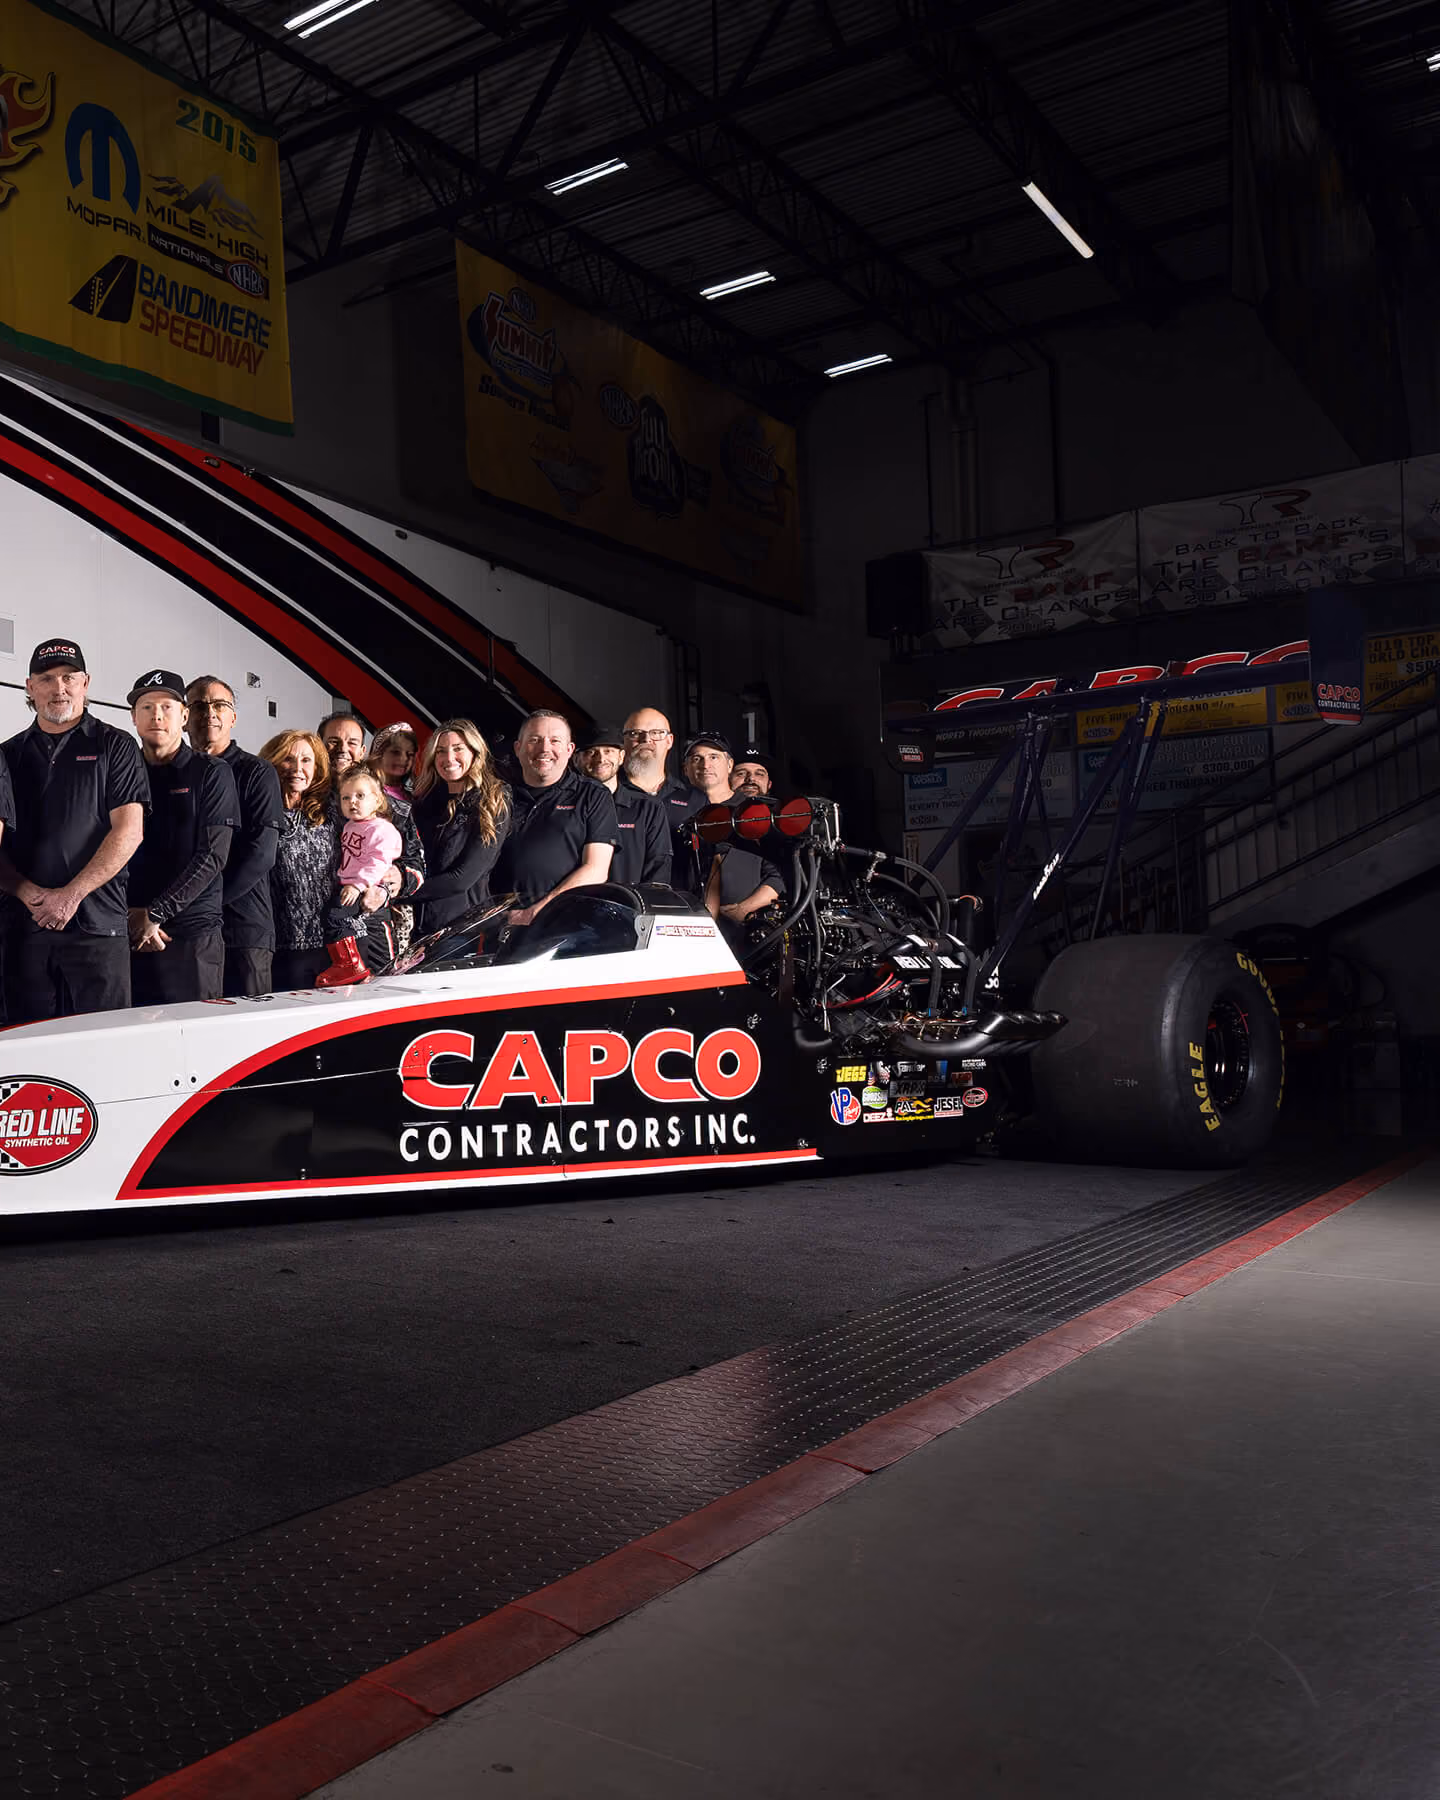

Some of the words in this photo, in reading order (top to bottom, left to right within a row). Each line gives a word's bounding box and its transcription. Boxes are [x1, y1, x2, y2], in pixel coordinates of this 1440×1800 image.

[175, 99, 257, 164] 2015
[151, 233, 224, 274] NATIONALS
[138, 263, 271, 349] BANDIMERE
[139, 299, 265, 376] SPEEDWAY
[1175, 537, 1237, 555] BACK
[1295, 516, 1363, 535] BACK
[1152, 577, 1216, 595] ARE
[1240, 549, 1393, 581] CHAMPS
[1154, 556, 1218, 576] THE
[936, 615, 977, 630] ARE
[1001, 588, 1129, 620] CHAMPS
[944, 594, 998, 612] THE
[40, 645, 76, 655] CAPCO
[1318, 684, 1360, 702] CAPCO
[398, 1027, 762, 1111] CAPCO
[836, 1066, 866, 1082] JEGS
[1188, 1041, 1220, 1132] EAGLE
[38, 1107, 85, 1136] LINE
[831, 1088, 850, 1123] VP
[4, 1138, 53, 1148] SYNTHETIC
[55, 1137, 70, 1145] OIL
[399, 1116, 681, 1162] CONTRACTORS
[695, 1113, 756, 1146] INC.
